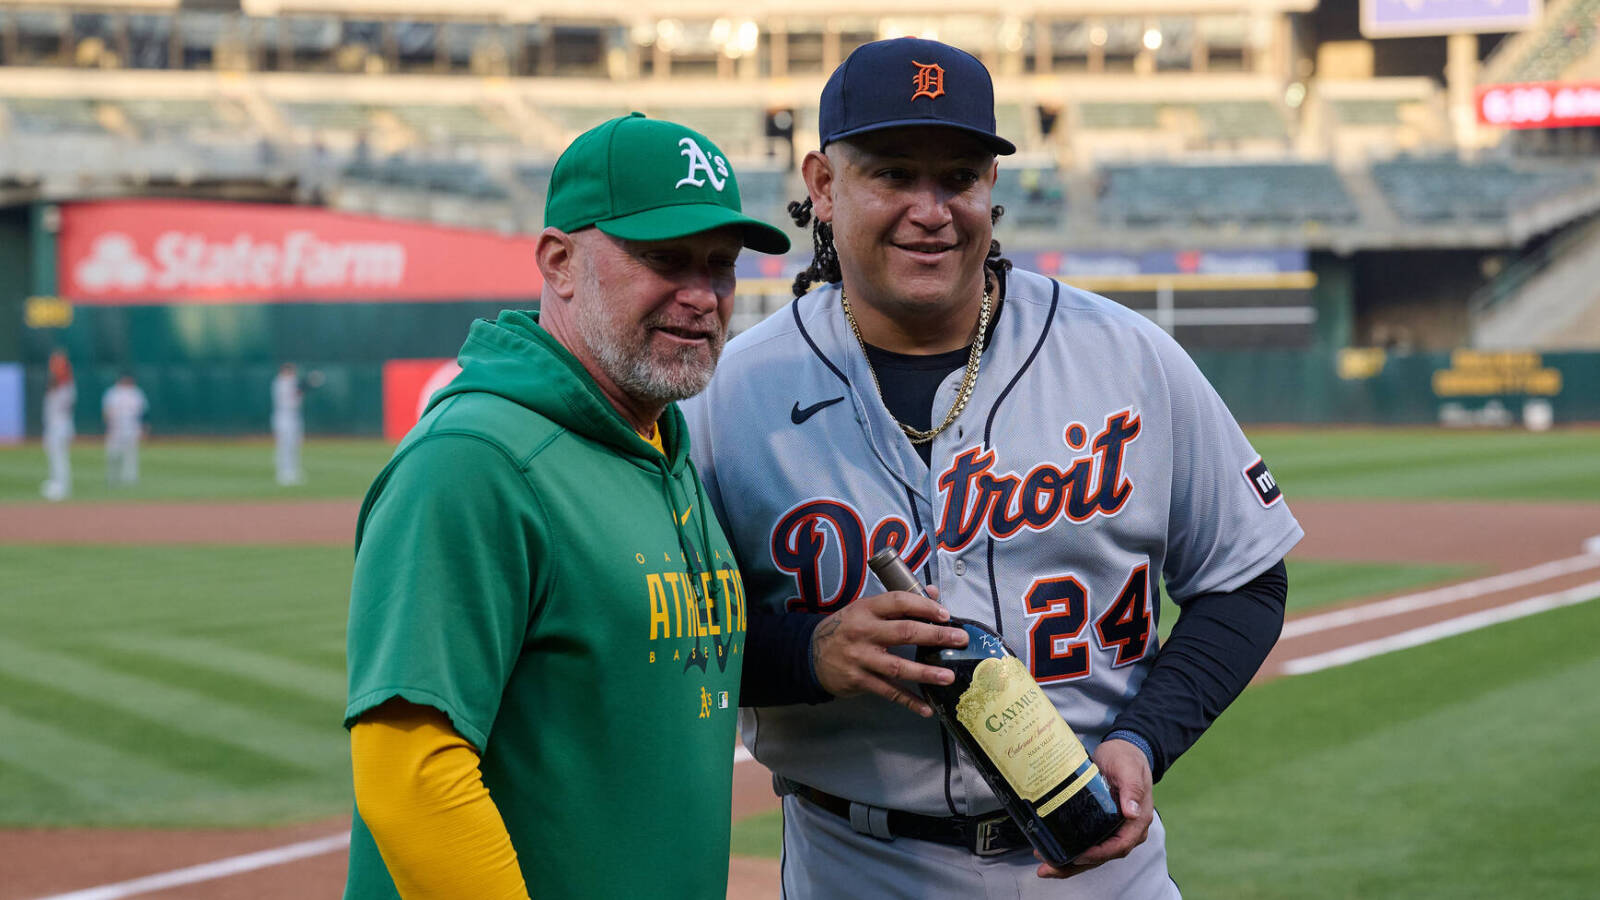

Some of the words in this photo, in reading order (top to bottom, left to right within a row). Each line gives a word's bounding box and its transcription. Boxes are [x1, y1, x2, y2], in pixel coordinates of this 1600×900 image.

[911, 60, 946, 102] D
[675, 137, 729, 191] A's
[769, 405, 1142, 615] Detroit
[1021, 554, 1154, 685] 24
[985, 688, 1038, 733] CAYMUS
